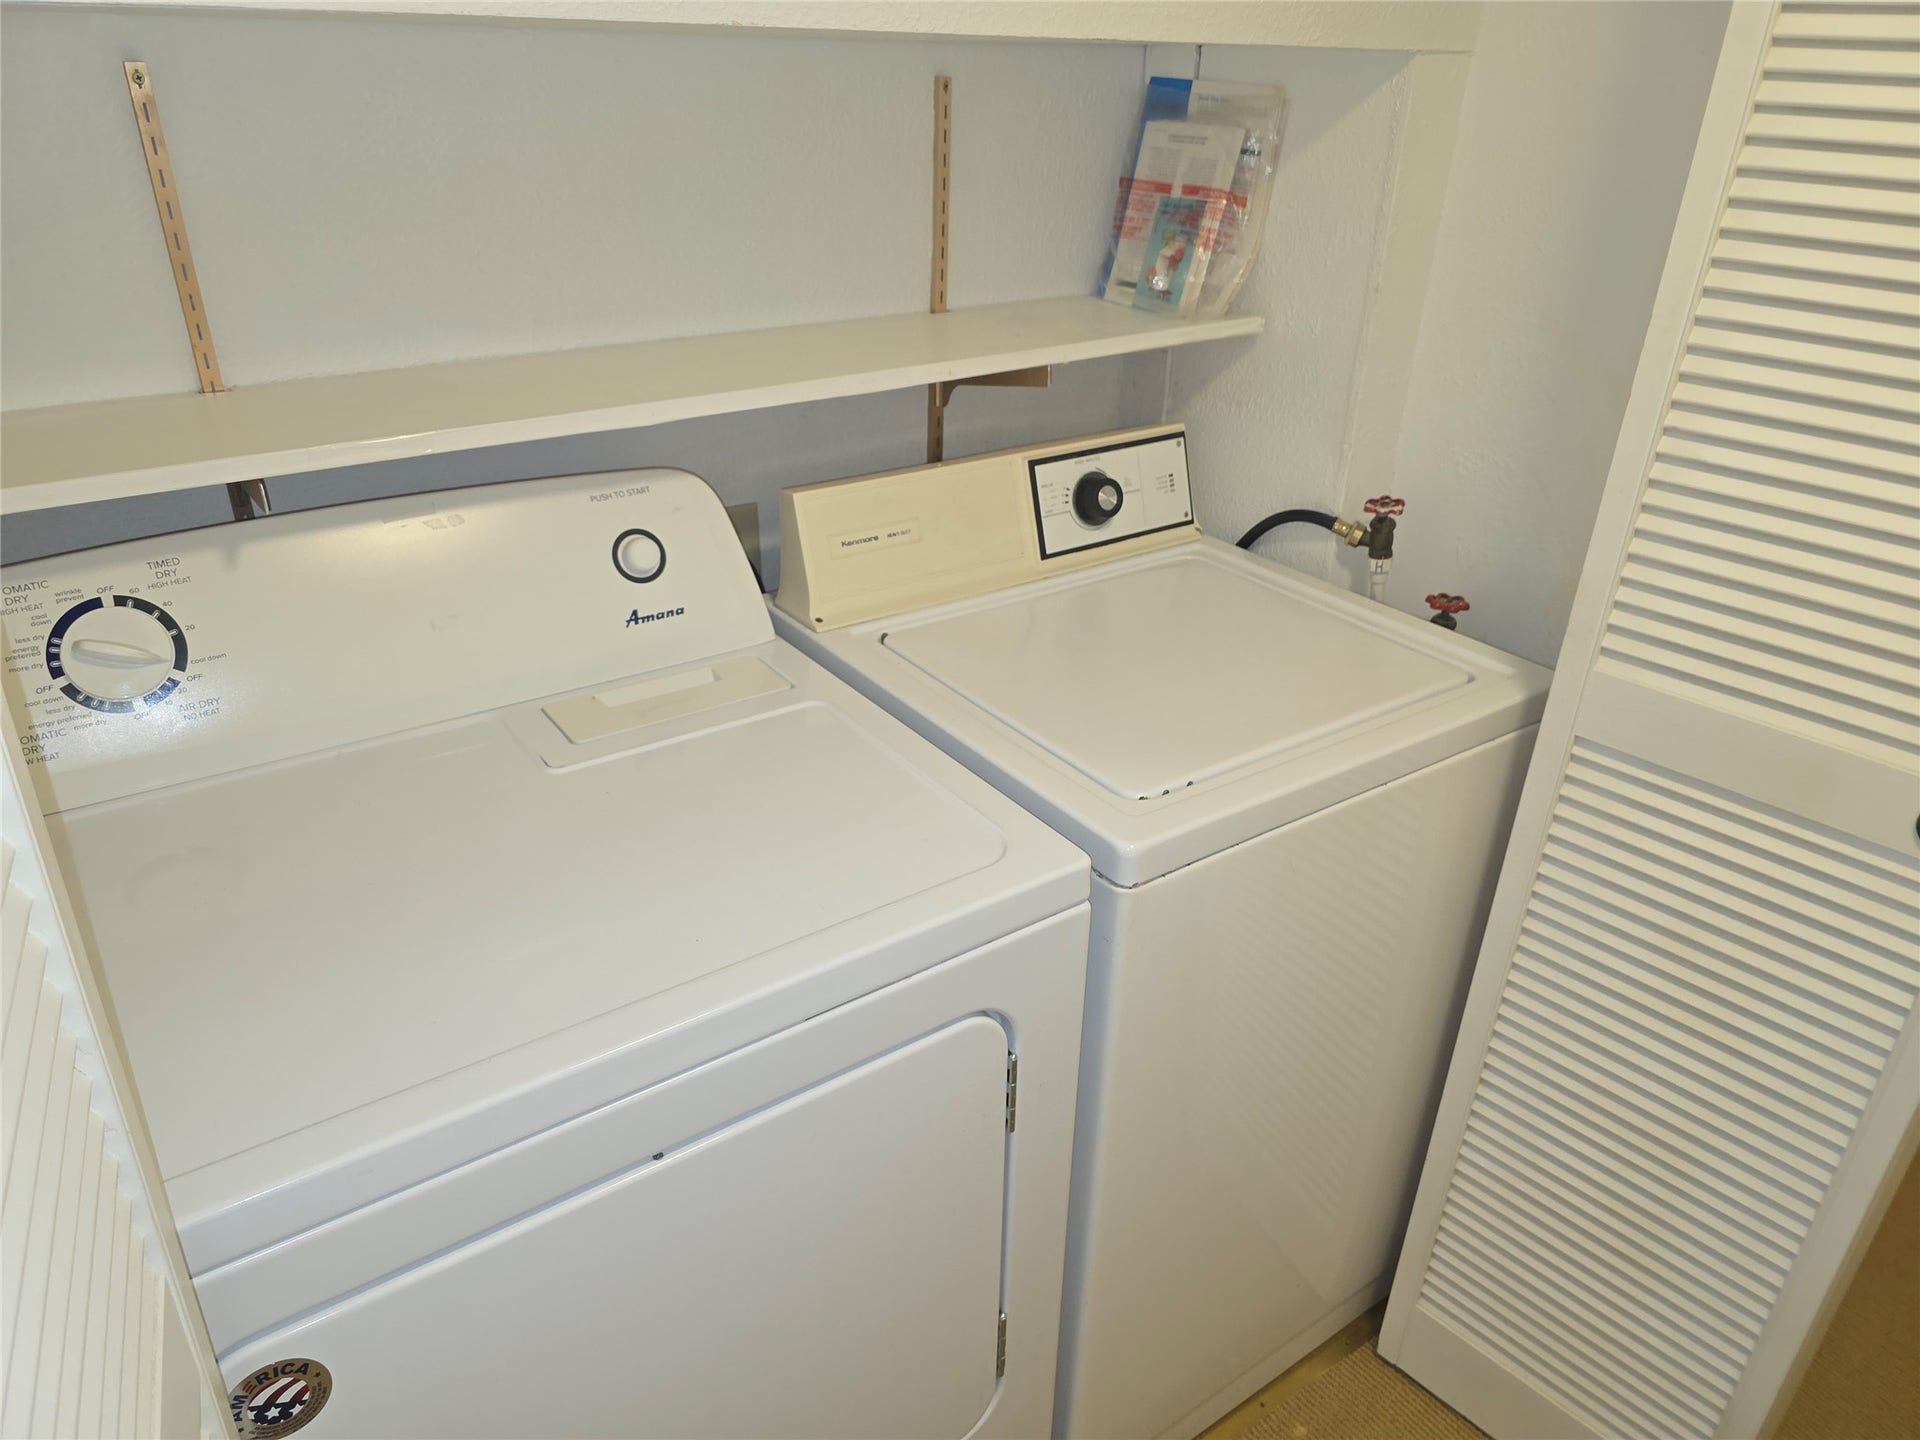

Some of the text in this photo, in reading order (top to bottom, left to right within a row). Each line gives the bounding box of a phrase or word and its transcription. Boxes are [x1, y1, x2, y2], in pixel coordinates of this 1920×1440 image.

[590, 486, 650, 503] PUSH TO START
[841, 535, 879, 548] Kenmore
[146, 557, 181, 570] TIMED
[155, 569, 178, 580] DRY
[2, 580, 49, 595] OMATIC
[147, 575, 192, 591] HIGH HEAT
[54, 588, 82, 598] wrinkle
[96, 585, 115, 595] OFF
[129, 587, 140, 595] 60
[4, 594, 29, 607] DRY
[55, 593, 85, 605] prevent
[20, 602, 44, 613] HEAT
[30, 618, 52, 628] down
[31, 612, 48, 622] cool
[625, 606, 685, 629] Amana
[185, 624, 196, 632] 20
[15, 633, 45, 645] less dry
[4, 650, 42, 663] preferred
[12, 644, 40, 656] energy
[190, 652, 227, 666] cool down
[8, 662, 44, 674] more dry
[186, 673, 203, 683] OFF
[35, 684, 55, 695] OFF
[24, 694, 64, 709] cool down
[178, 696, 221, 714] AIR DRY
[45, 704, 76, 716] less dry
[183, 707, 222, 722] NO HEAT
[19, 730, 67, 745] OMATIC
[22, 743, 46, 757] DRY
[36, 751, 60, 764] HEAT
[231, 1362, 310, 1422] AMERICA
